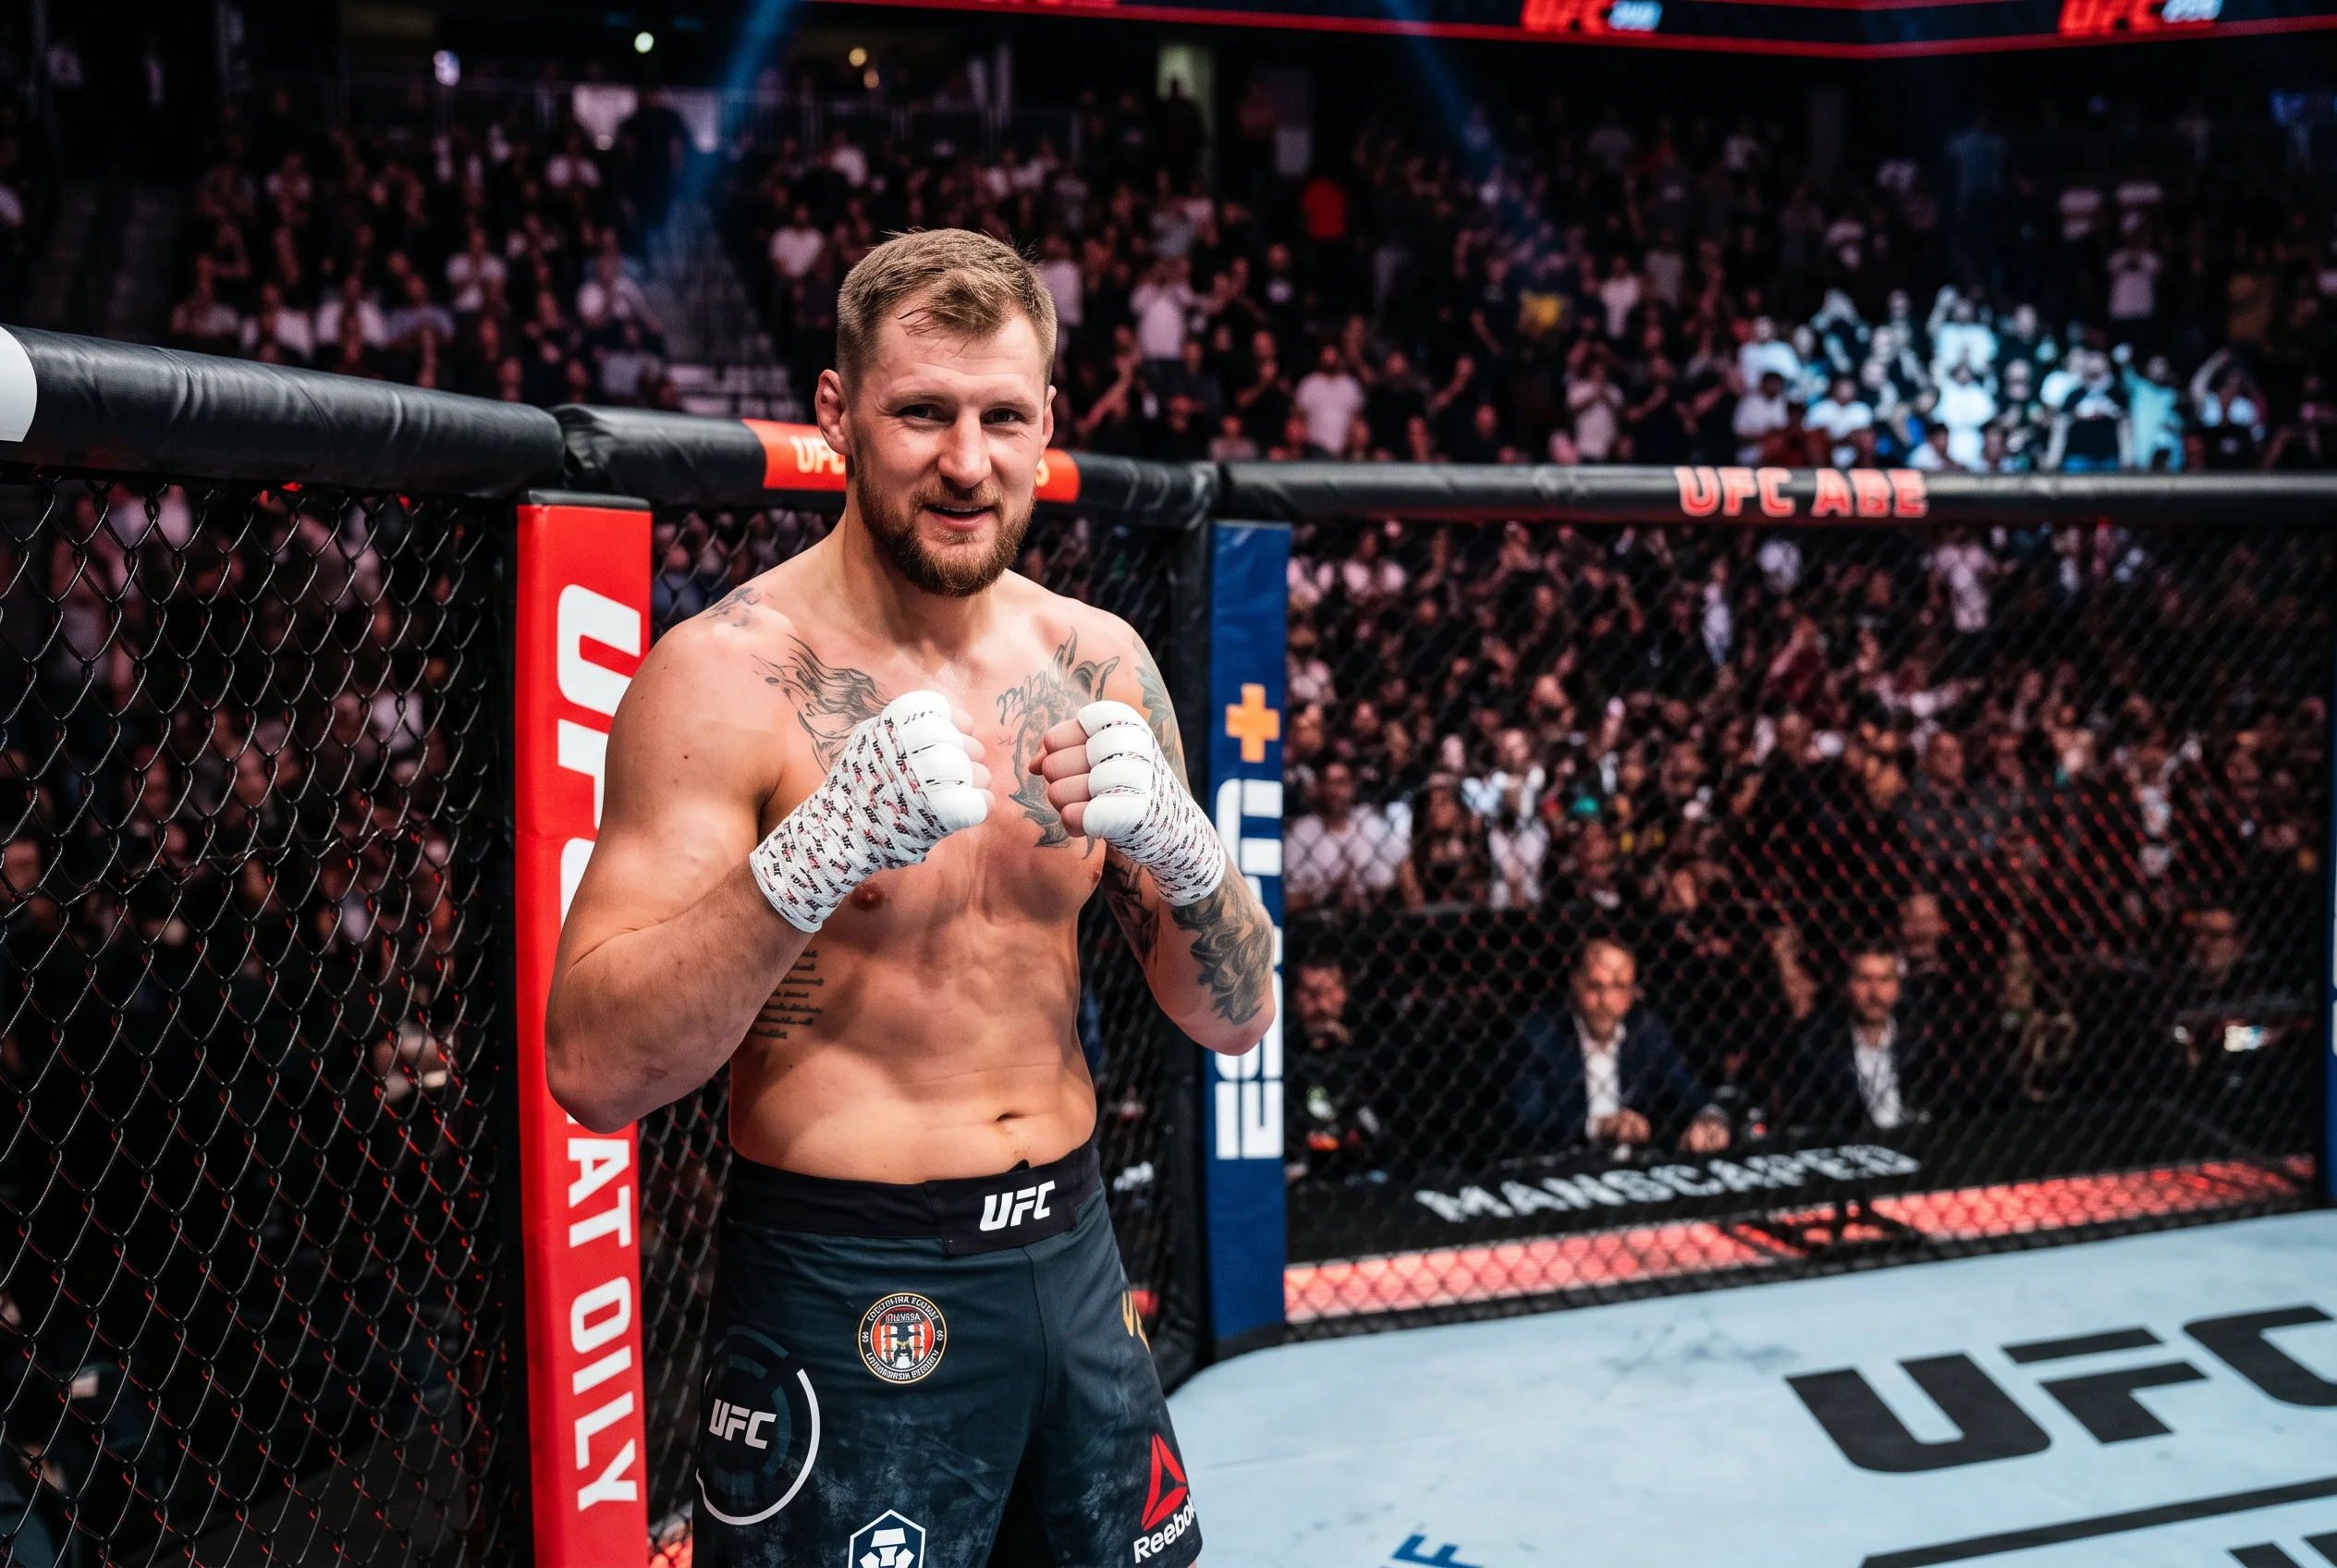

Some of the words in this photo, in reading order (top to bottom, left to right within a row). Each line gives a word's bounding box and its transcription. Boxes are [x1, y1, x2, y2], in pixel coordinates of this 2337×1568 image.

[1674, 466, 1796, 518] UFC
[1810, 468, 1929, 519] ABE
[567, 1112, 633, 1249] AT
[979, 1180, 1056, 1231] UFC
[569, 1277, 638, 1512] OILY
[709, 1398, 777, 1450] UFC
[1784, 1302, 2337, 1473] UFC
